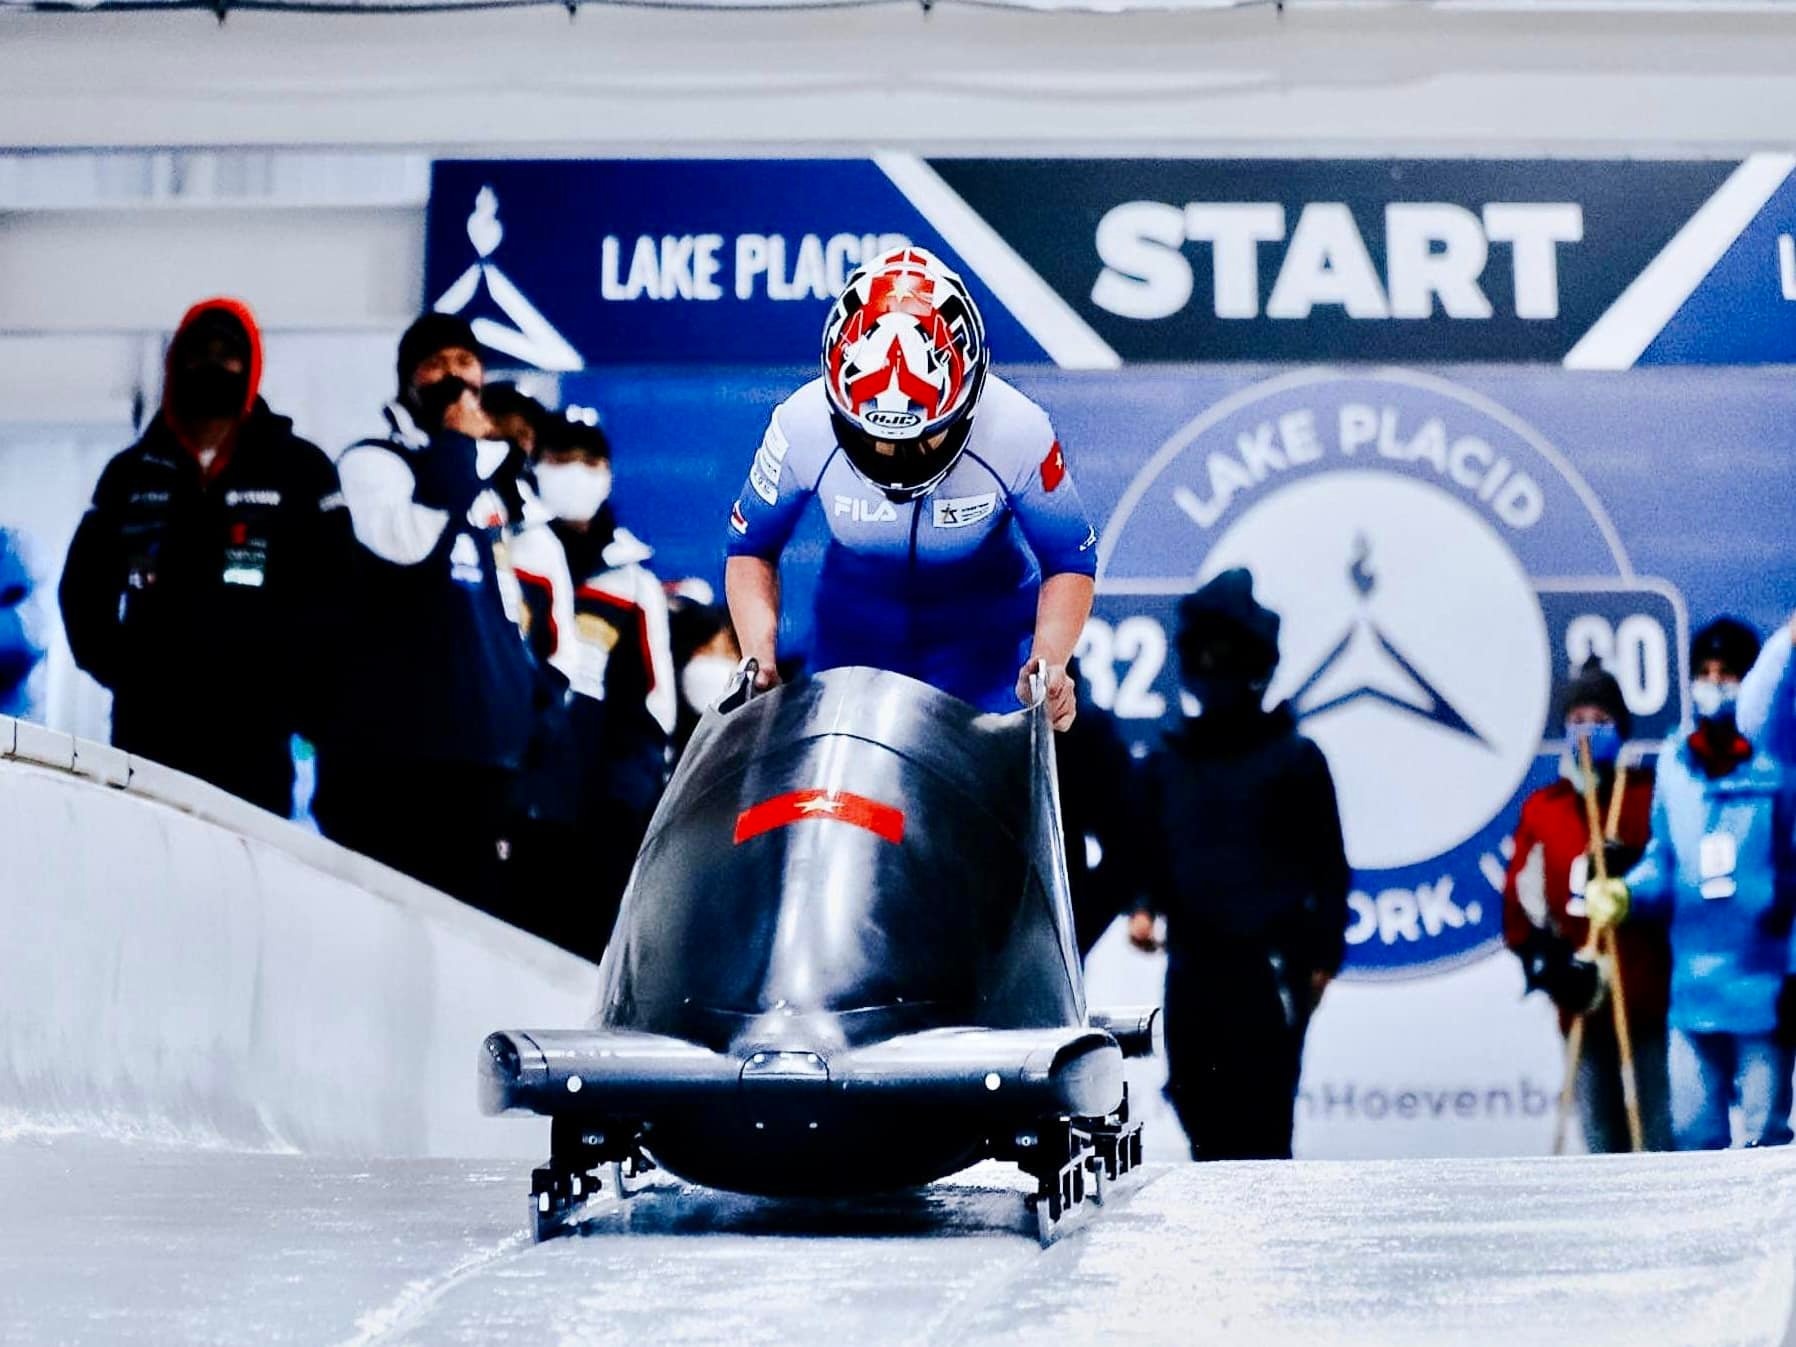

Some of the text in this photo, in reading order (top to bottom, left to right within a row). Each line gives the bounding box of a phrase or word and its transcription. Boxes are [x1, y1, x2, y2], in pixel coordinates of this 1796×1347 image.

[601, 233, 914, 300] LAKE PLAC
[1091, 200, 1584, 320] START
[871, 413, 914, 425] HJC
[1172, 402, 1544, 528] LAKE PLACID
[834, 495, 898, 522] FILA
